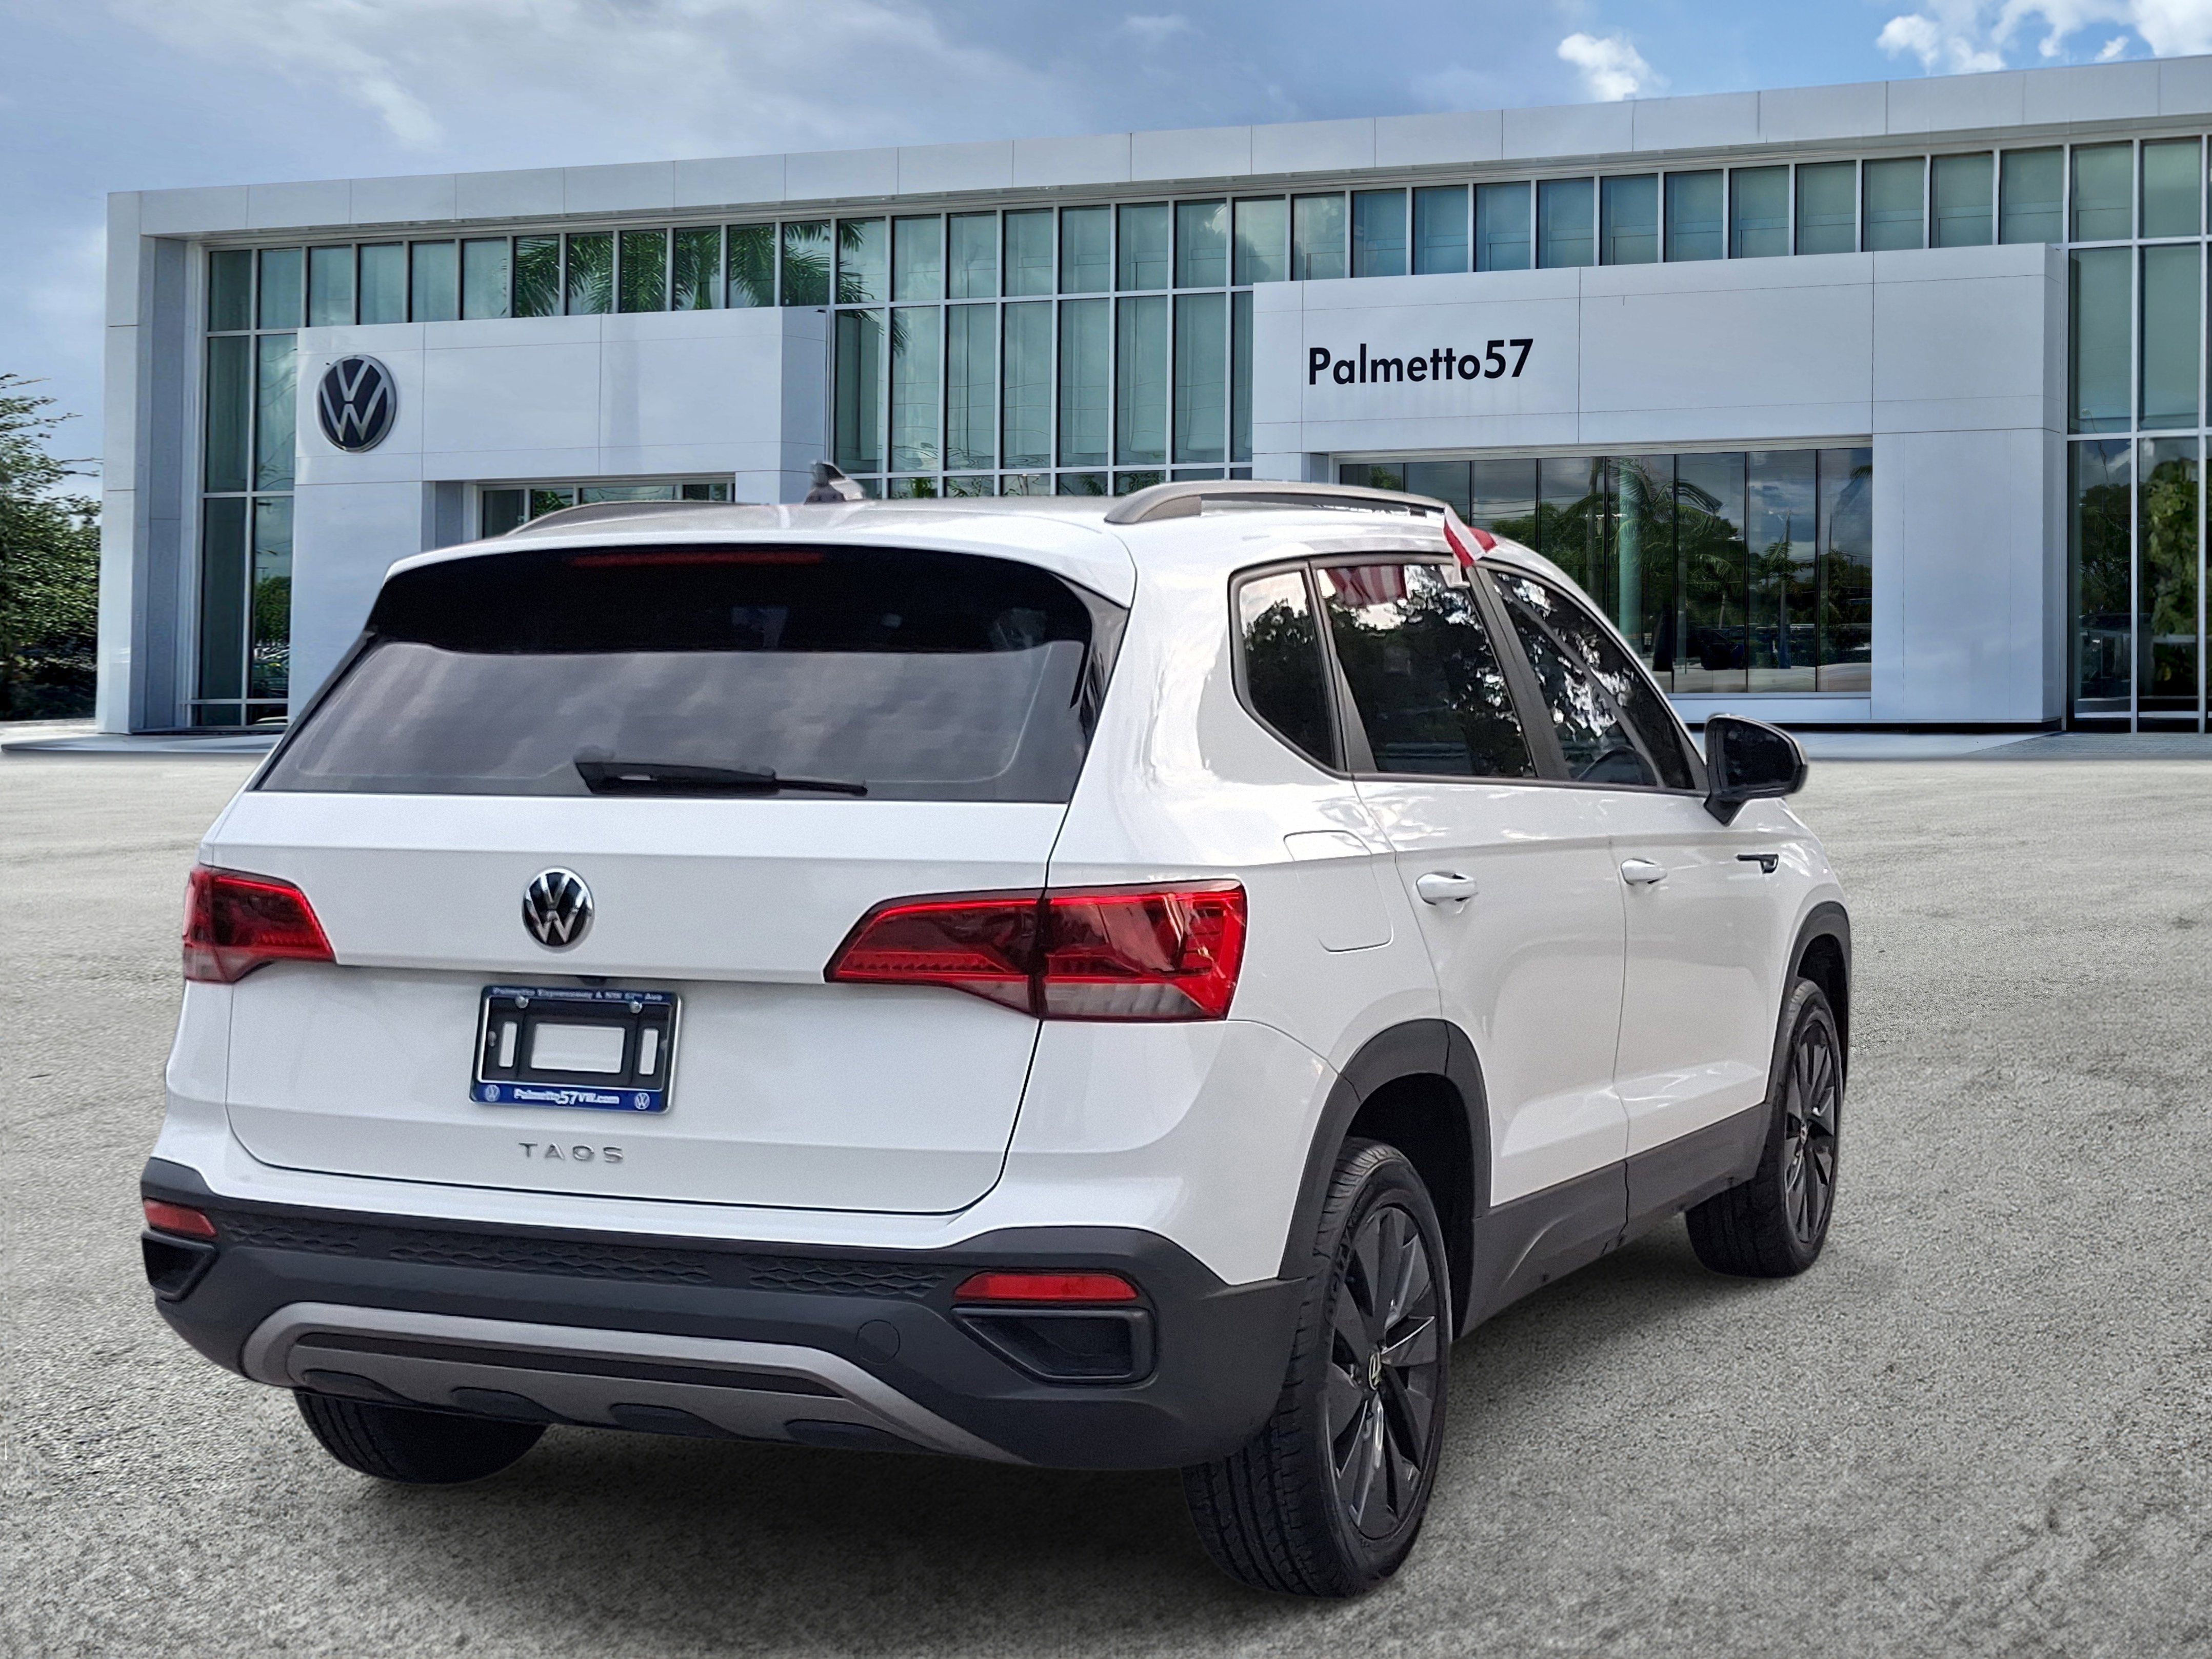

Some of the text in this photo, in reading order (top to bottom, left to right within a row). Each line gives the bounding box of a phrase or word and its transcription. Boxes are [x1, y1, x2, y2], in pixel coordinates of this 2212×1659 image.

[1308, 338, 1534, 385] Palmetto57
[317, 354, 396, 453] VW
[522, 866, 594, 949] VW
[519, 1142, 623, 1163] TAOS
